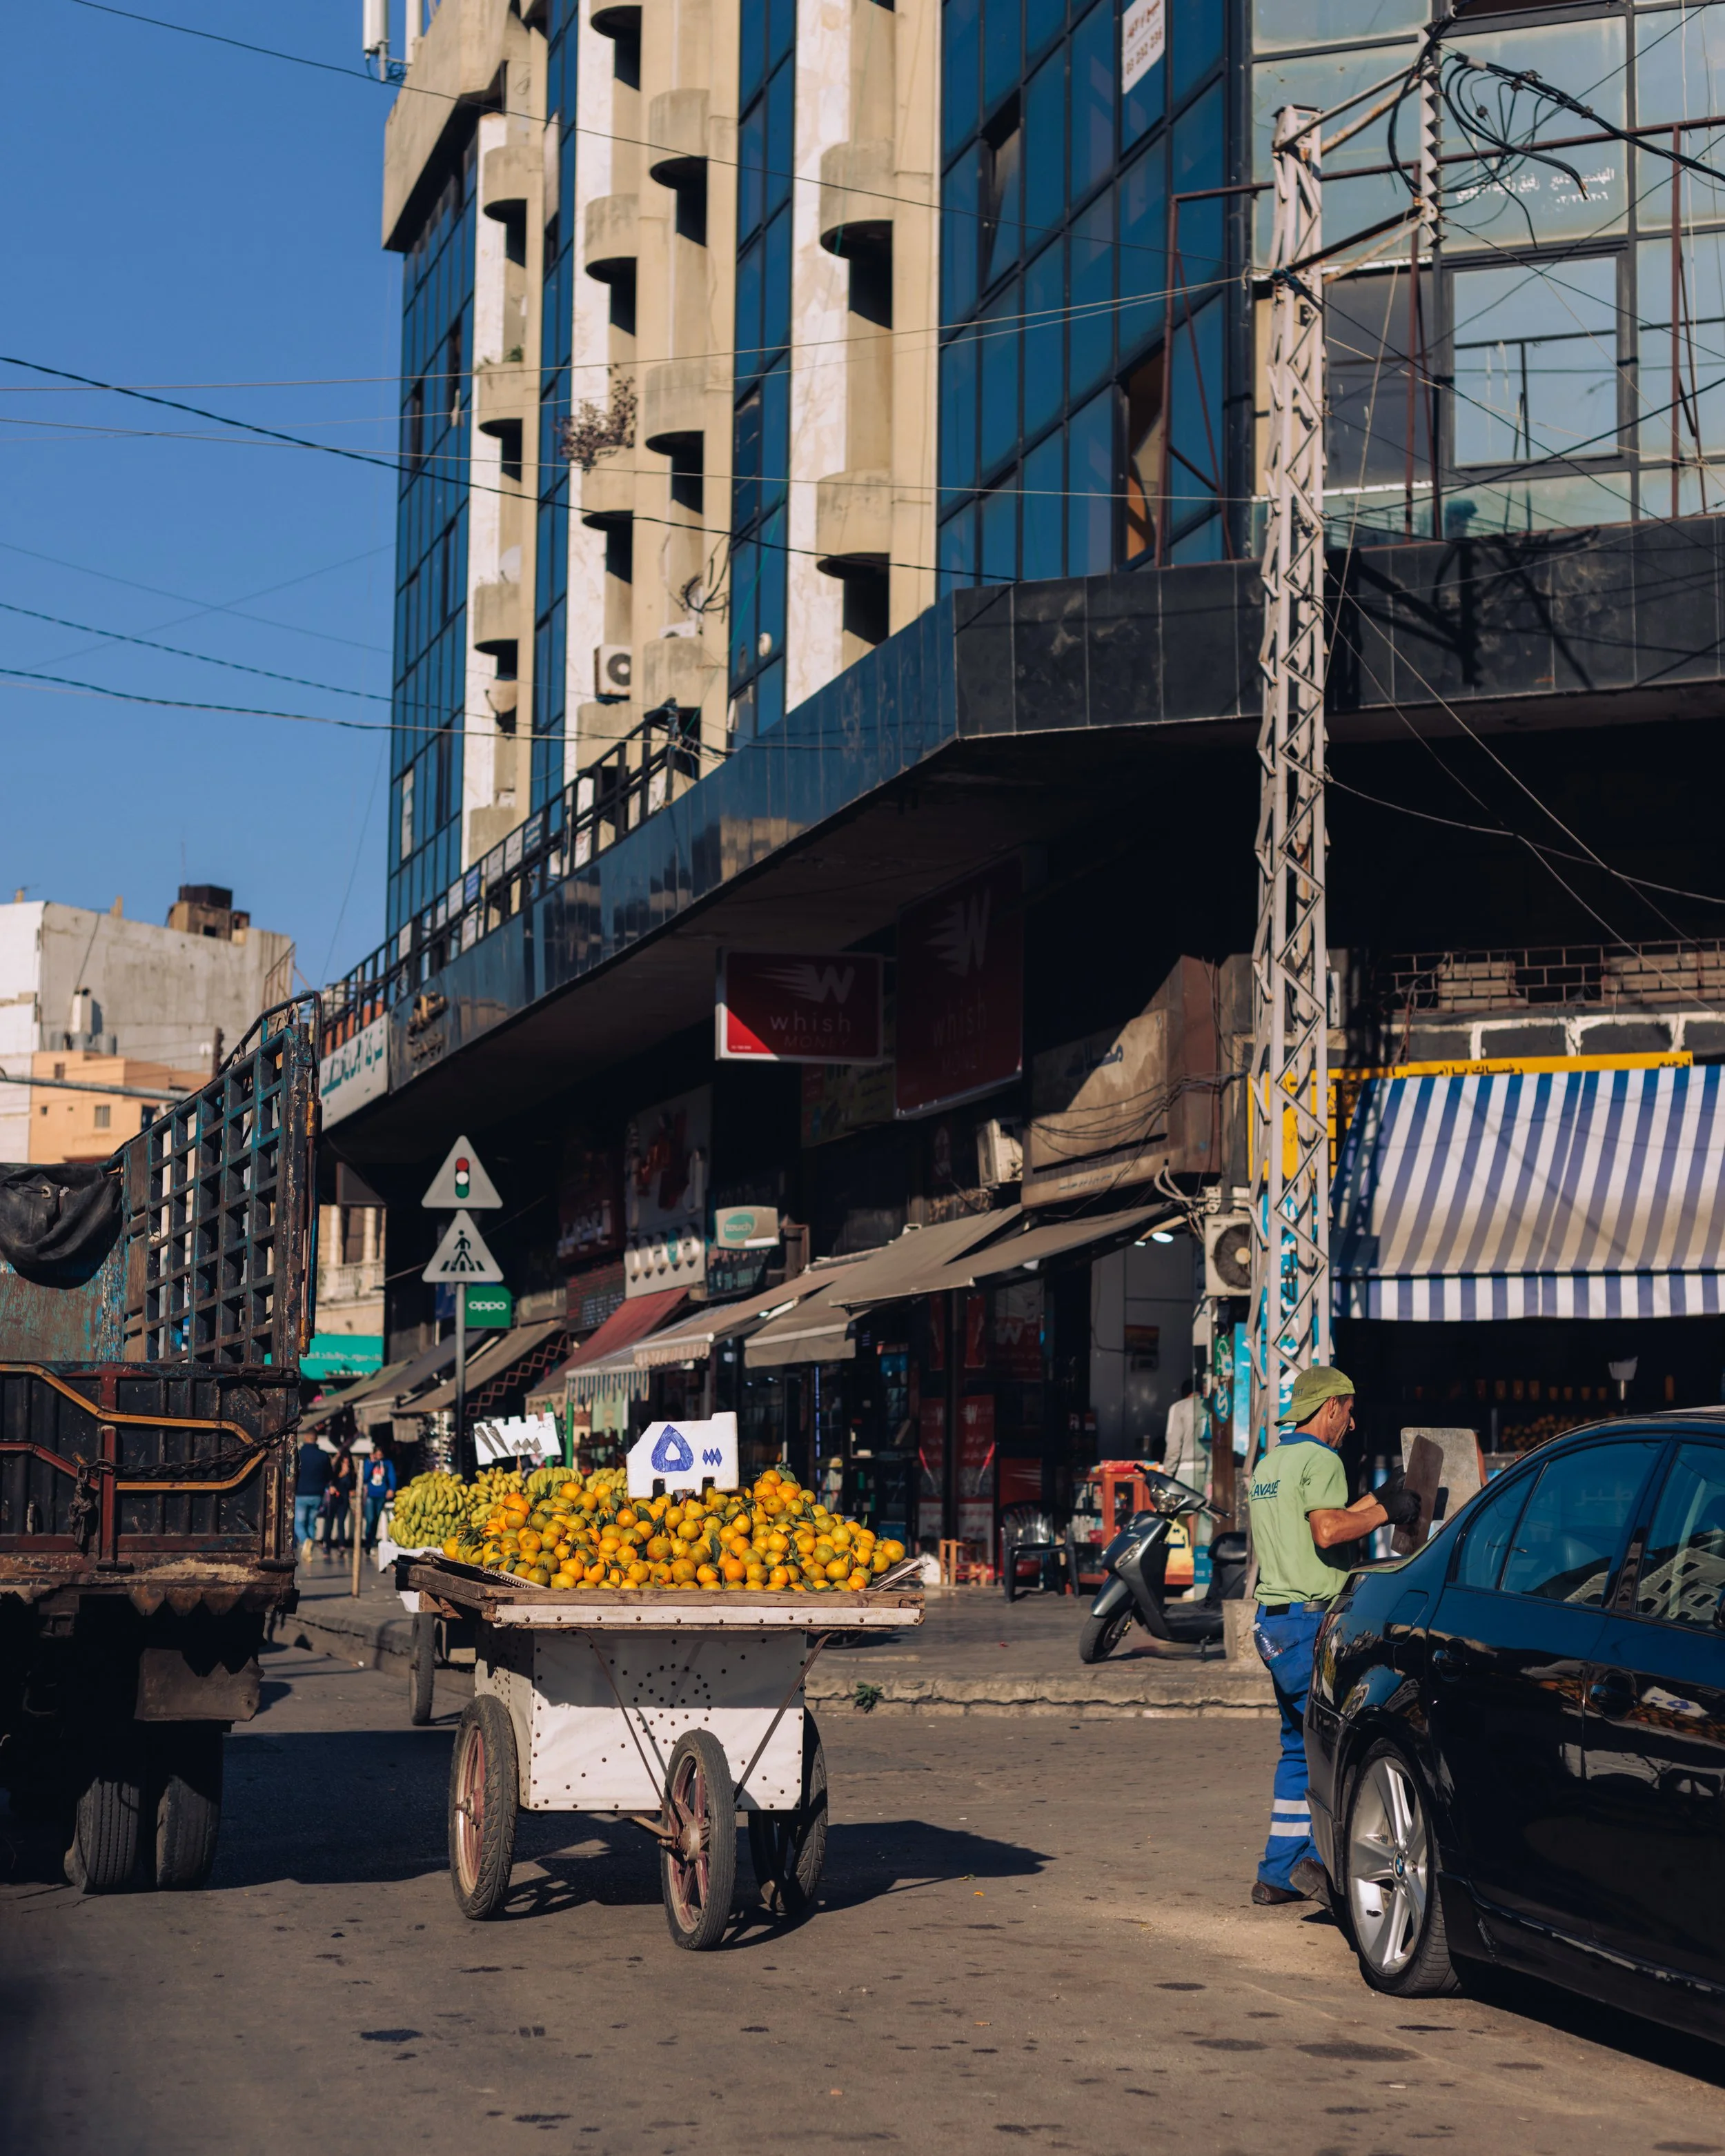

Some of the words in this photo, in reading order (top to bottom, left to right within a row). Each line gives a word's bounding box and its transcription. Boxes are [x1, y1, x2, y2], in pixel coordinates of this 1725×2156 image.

[770, 1010, 851, 1034] whish
[784, 1035, 849, 1051] MONEY
[725, 1221, 752, 1232] touch
[469, 1300, 507, 1312] oppo
